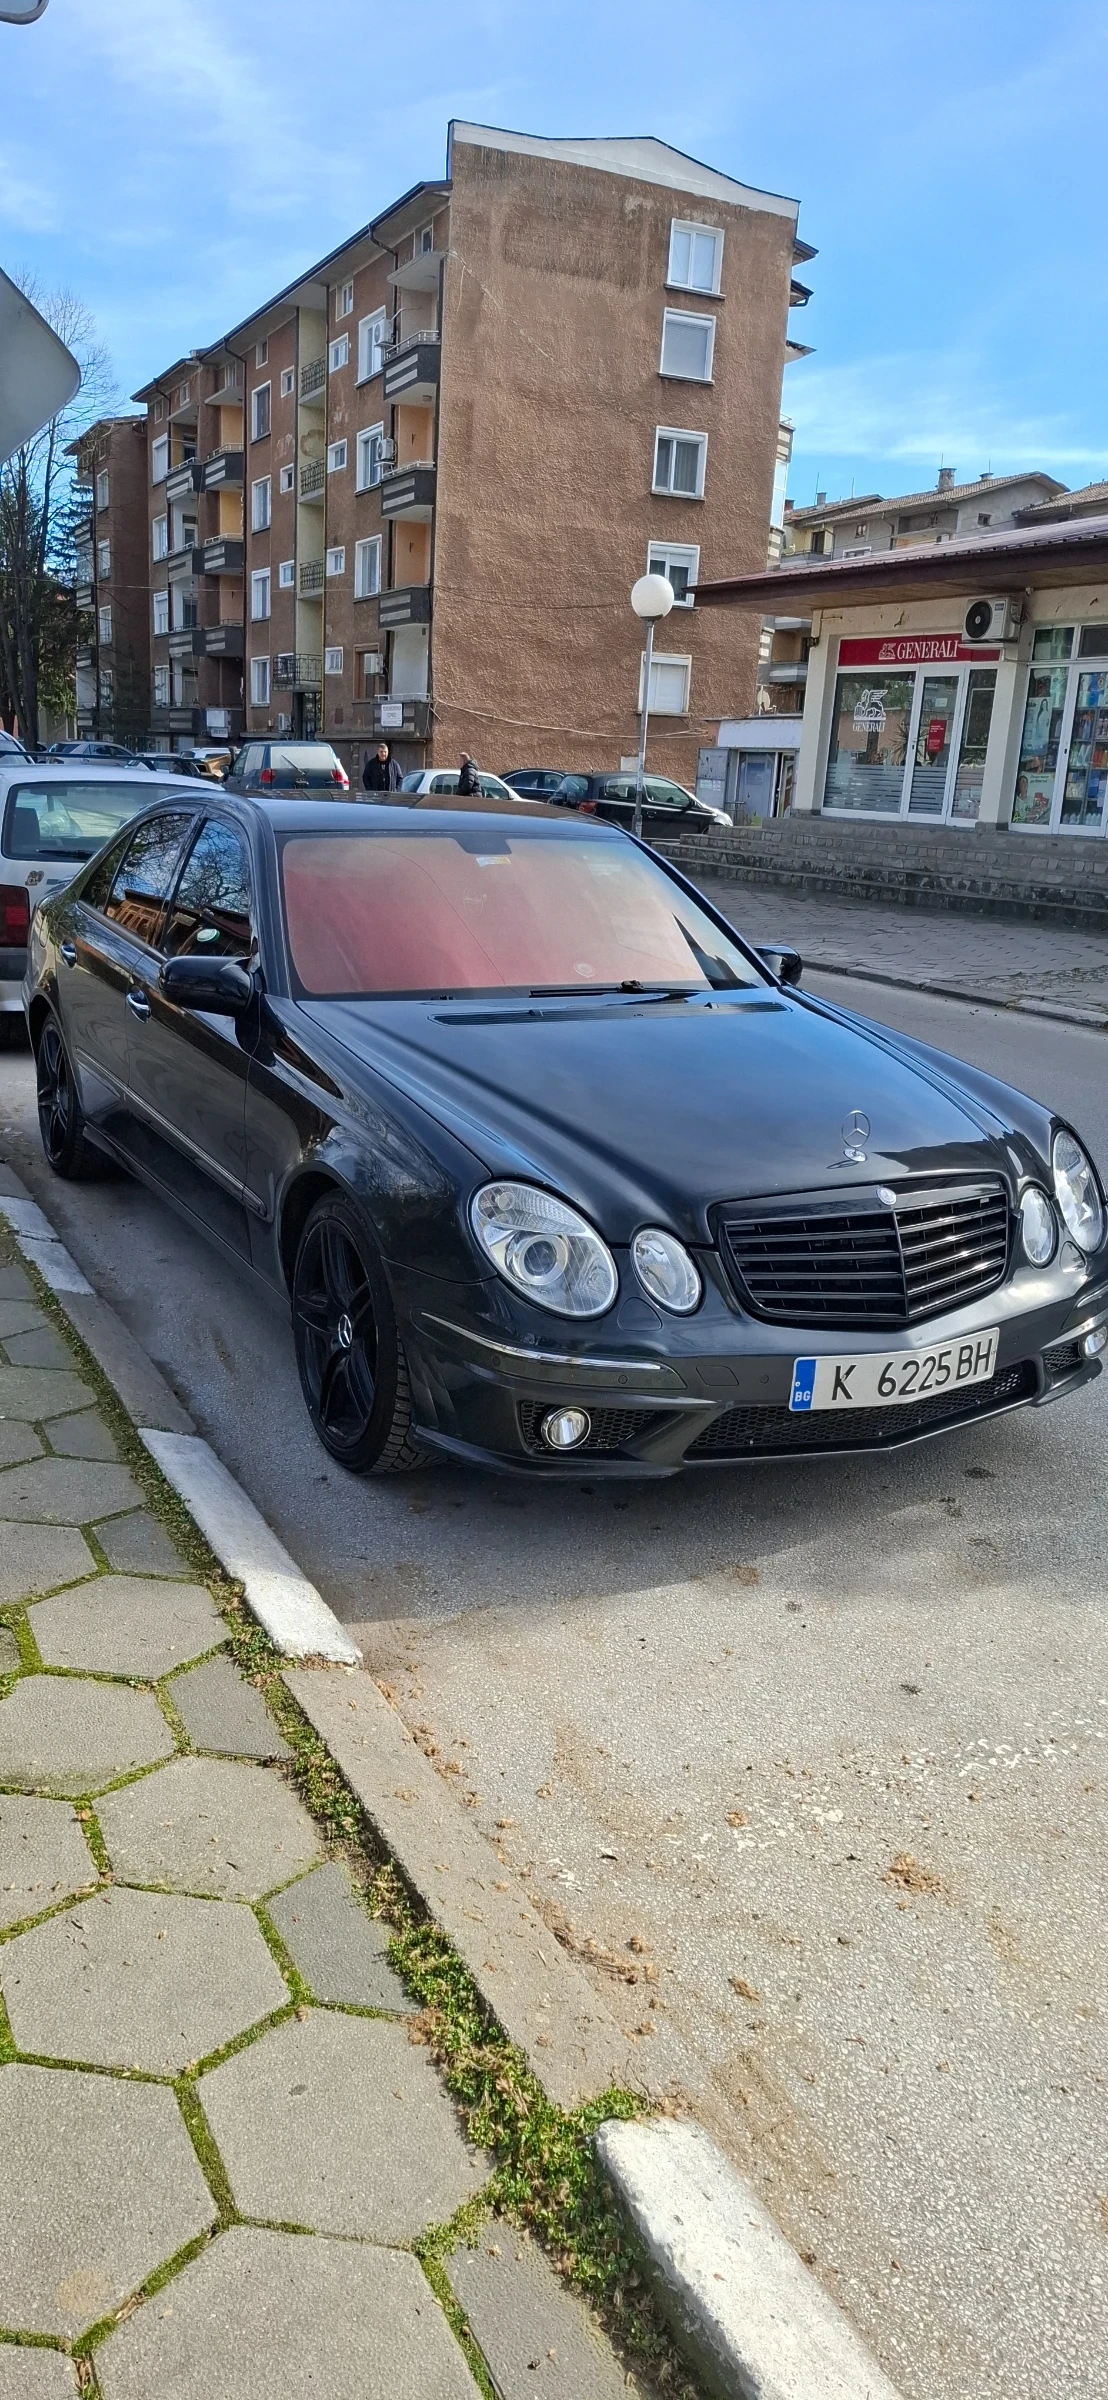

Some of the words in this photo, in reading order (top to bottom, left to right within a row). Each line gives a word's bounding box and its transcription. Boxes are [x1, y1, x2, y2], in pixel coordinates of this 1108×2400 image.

[897, 640, 959, 660] GENERALI
[852, 721, 886, 732] GENERALI
[831, 1364, 857, 1401] K
[877, 1350, 953, 1397] 6225
[955, 1337, 994, 1380] BH
[794, 1390, 811, 1402] BG
